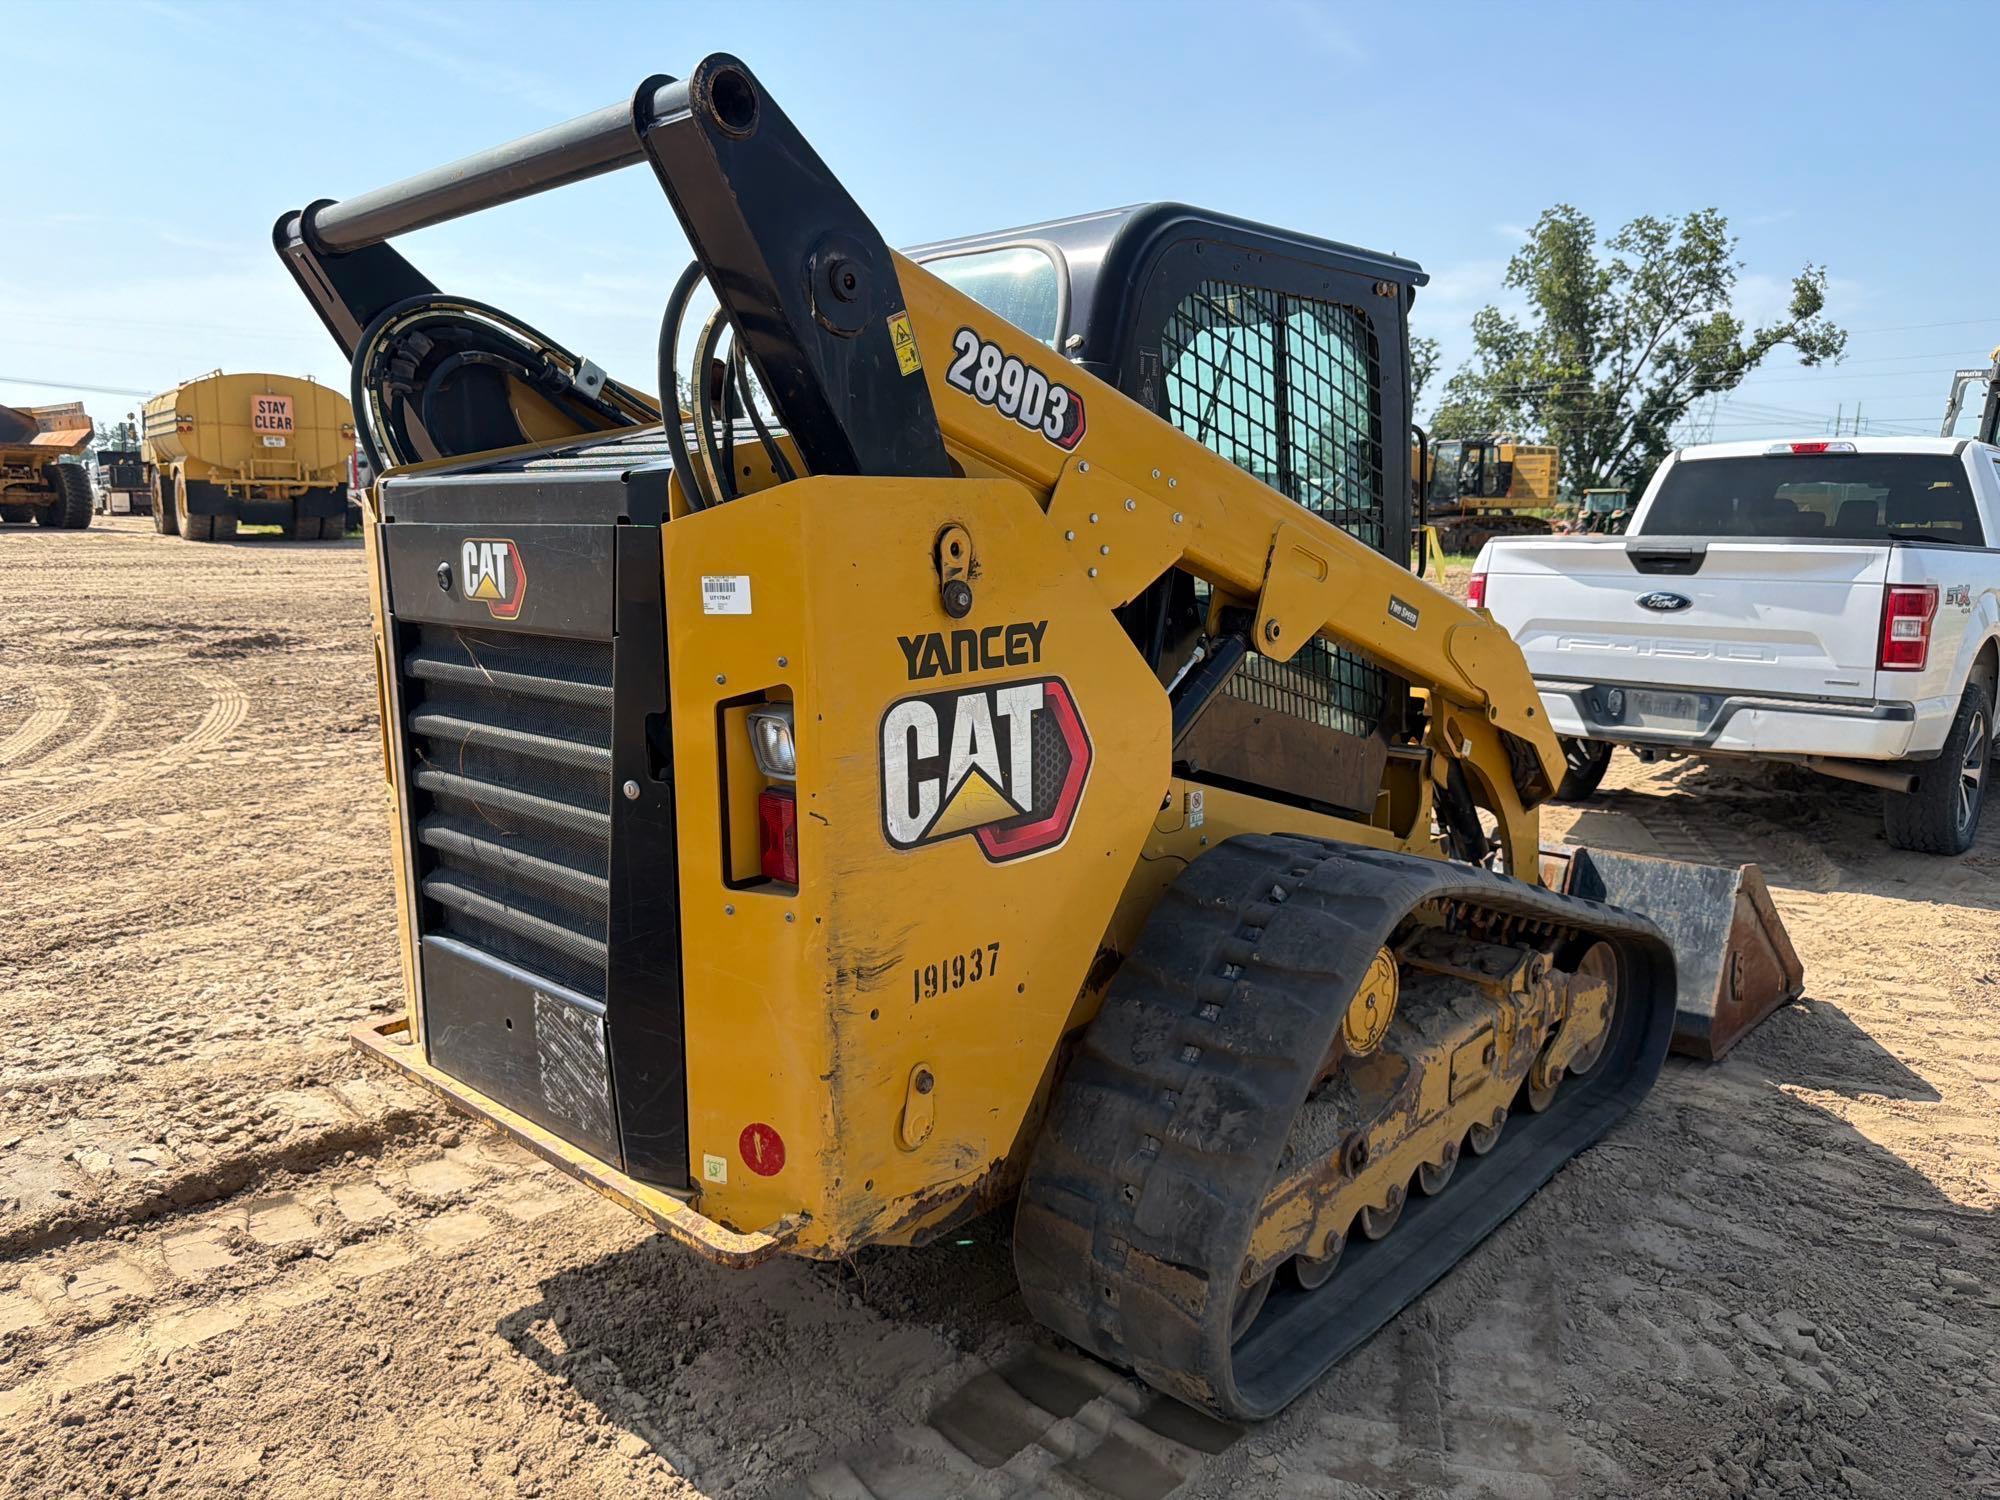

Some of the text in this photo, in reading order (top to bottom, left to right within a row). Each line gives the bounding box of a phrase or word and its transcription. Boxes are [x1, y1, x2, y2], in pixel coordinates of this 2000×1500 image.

[948, 329, 1070, 440] 289D3
[255, 415, 292, 430] CLEAR
[258, 400, 286, 415] STAY
[462, 541, 508, 599] CAT
[1647, 593, 1679, 609] Ford
[1945, 584, 1971, 607] STX
[896, 620, 1049, 680] YANCEY
[1556, 634, 1779, 665] F-150
[883, 683, 1044, 844] CAT
[914, 942, 1000, 1004] 191937
